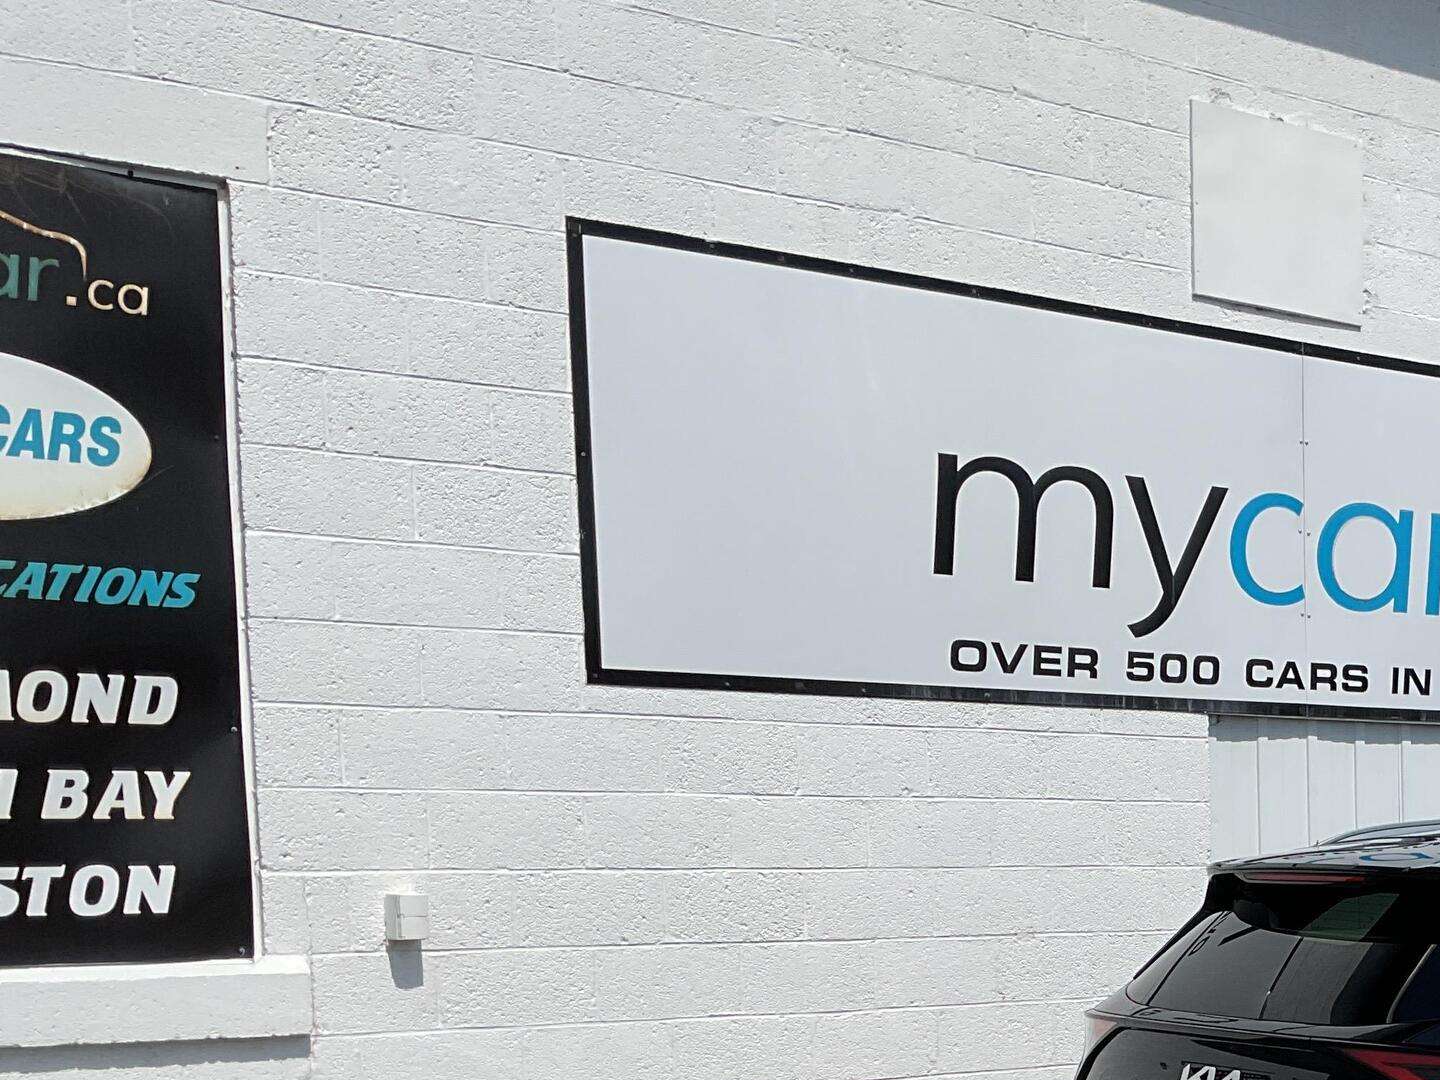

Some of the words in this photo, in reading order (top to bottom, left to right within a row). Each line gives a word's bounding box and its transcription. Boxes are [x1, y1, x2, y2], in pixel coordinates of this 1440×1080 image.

[949, 638, 1099, 680] OVER
[1126, 651, 1221, 686] 500
[1245, 658, 1369, 694] CARS
[1391, 666, 1432, 696] IN
[0, 669, 179, 726] OND
[40, 768, 192, 821] BAY
